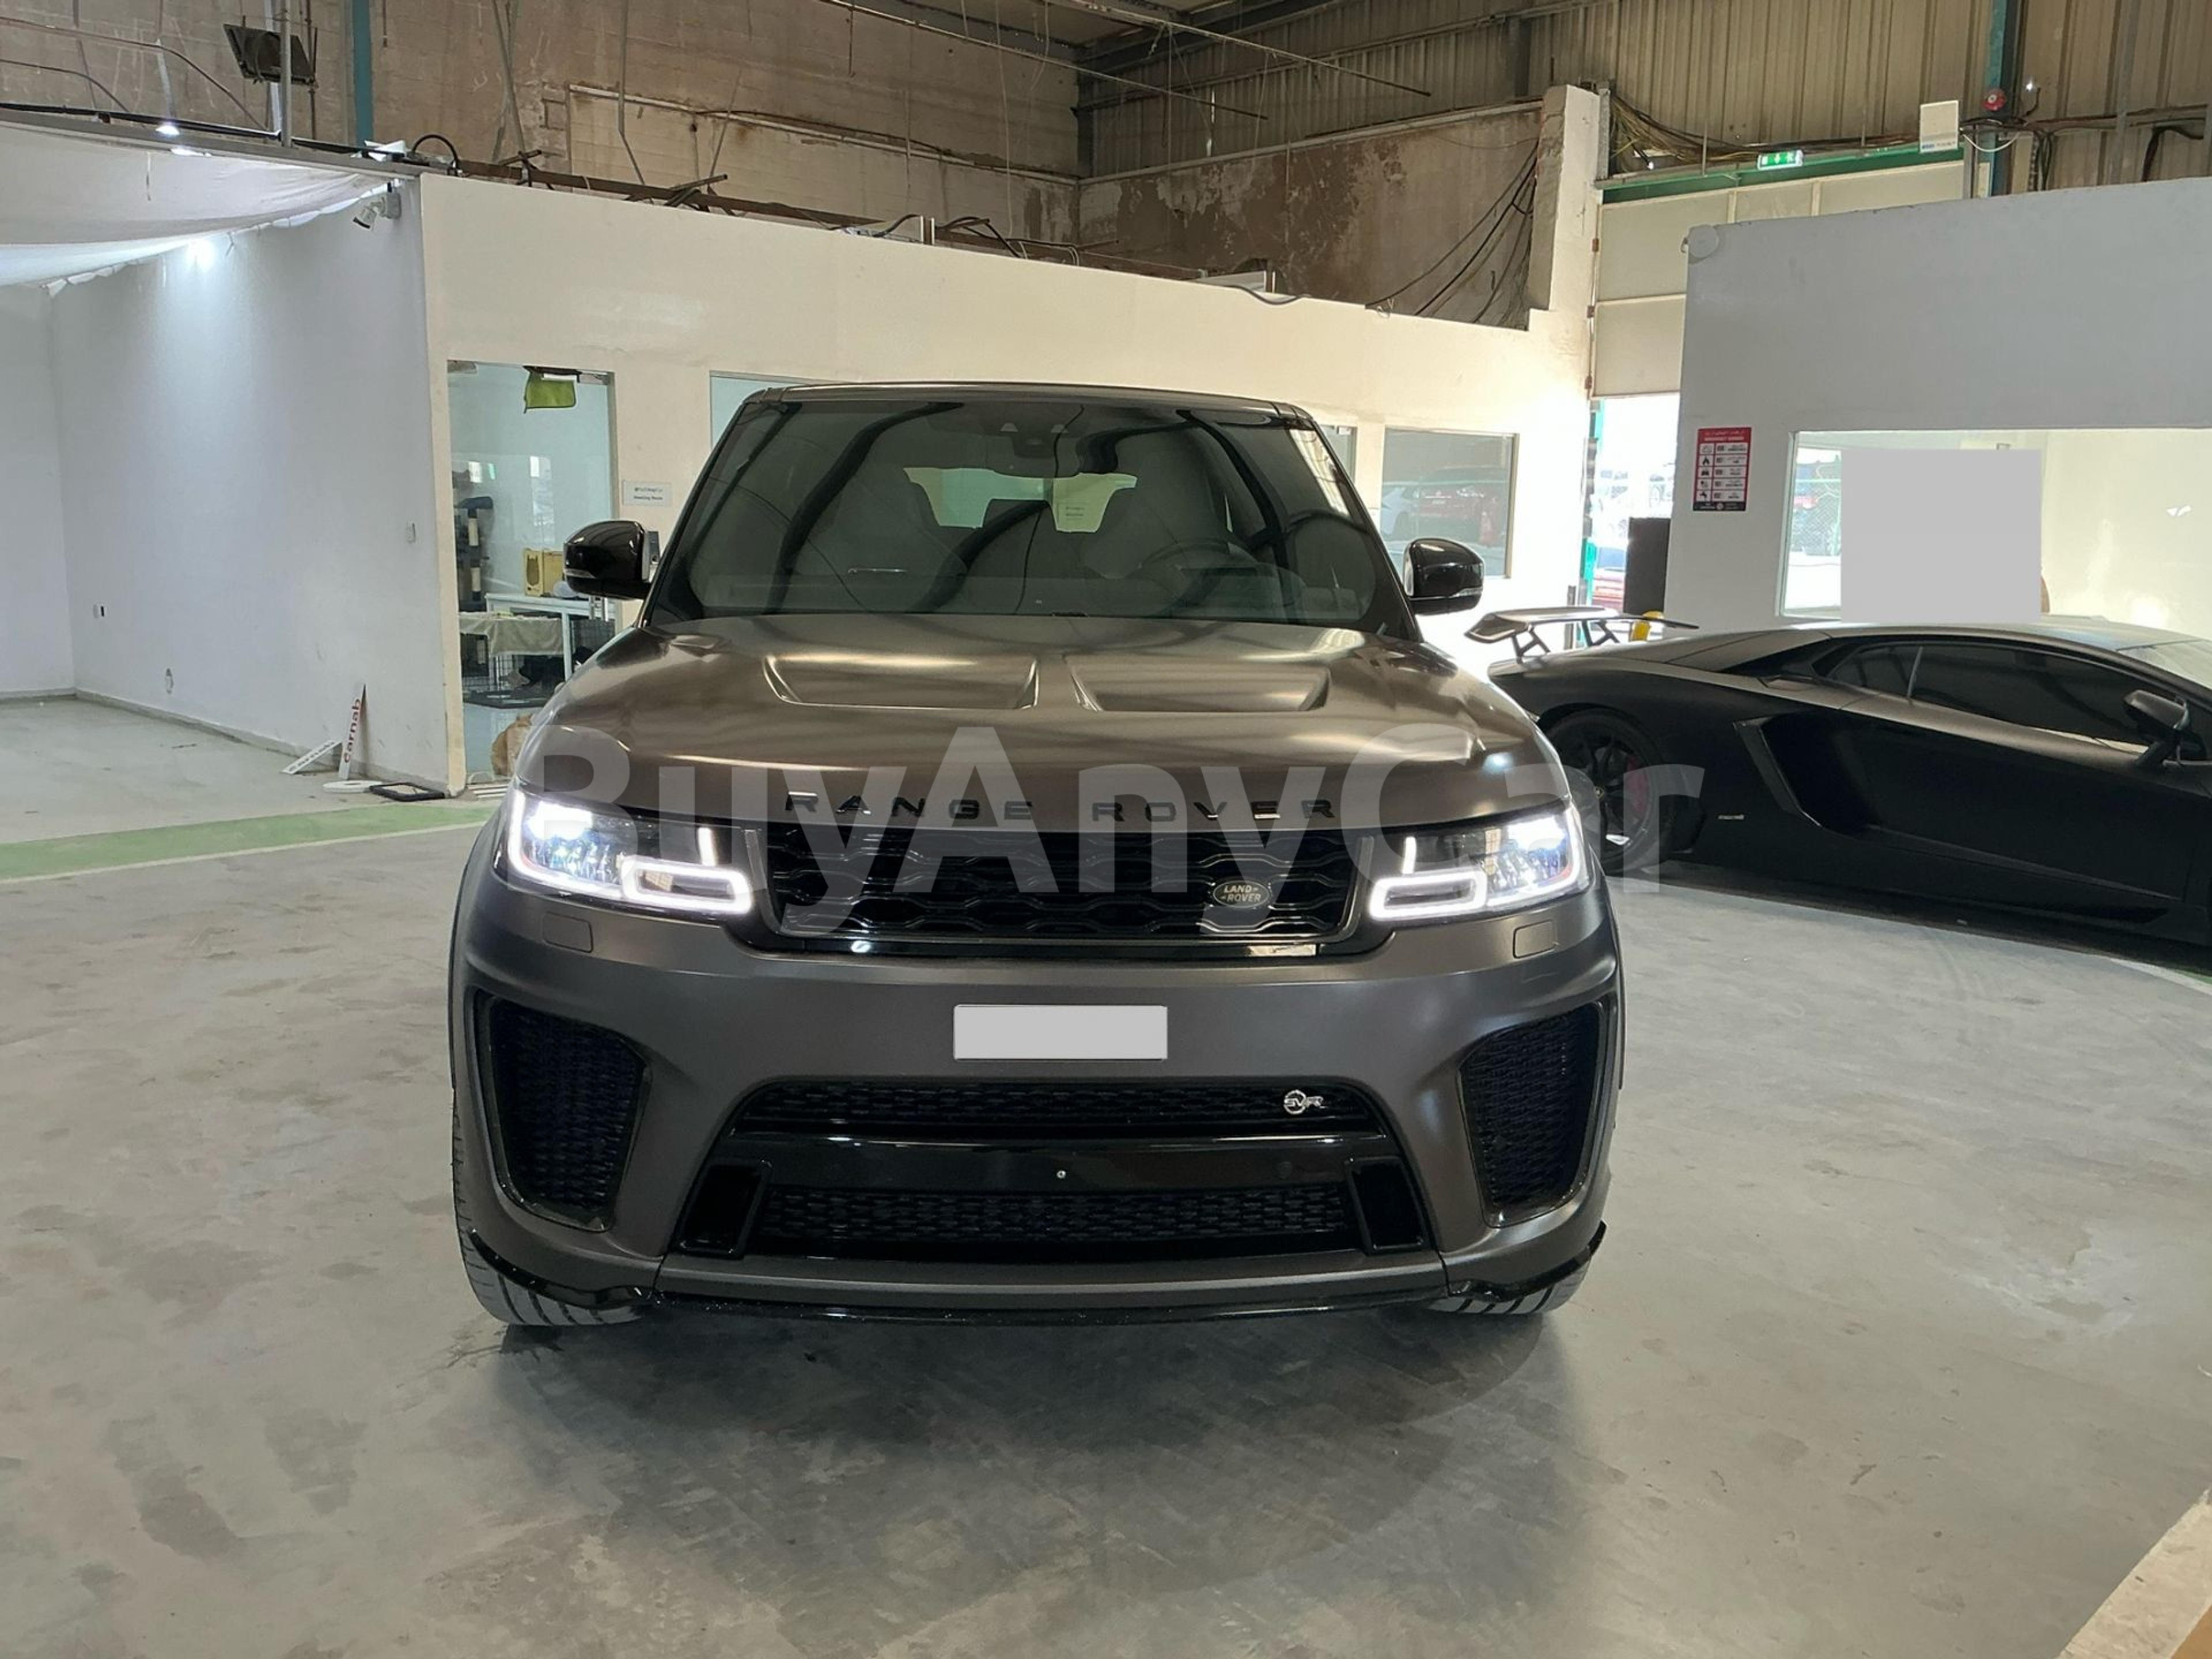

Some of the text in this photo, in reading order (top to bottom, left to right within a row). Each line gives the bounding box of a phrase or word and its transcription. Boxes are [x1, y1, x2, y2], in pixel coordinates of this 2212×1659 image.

[344, 698, 360, 763] carnab
[785, 791, 1336, 822] RANGE ROVER
